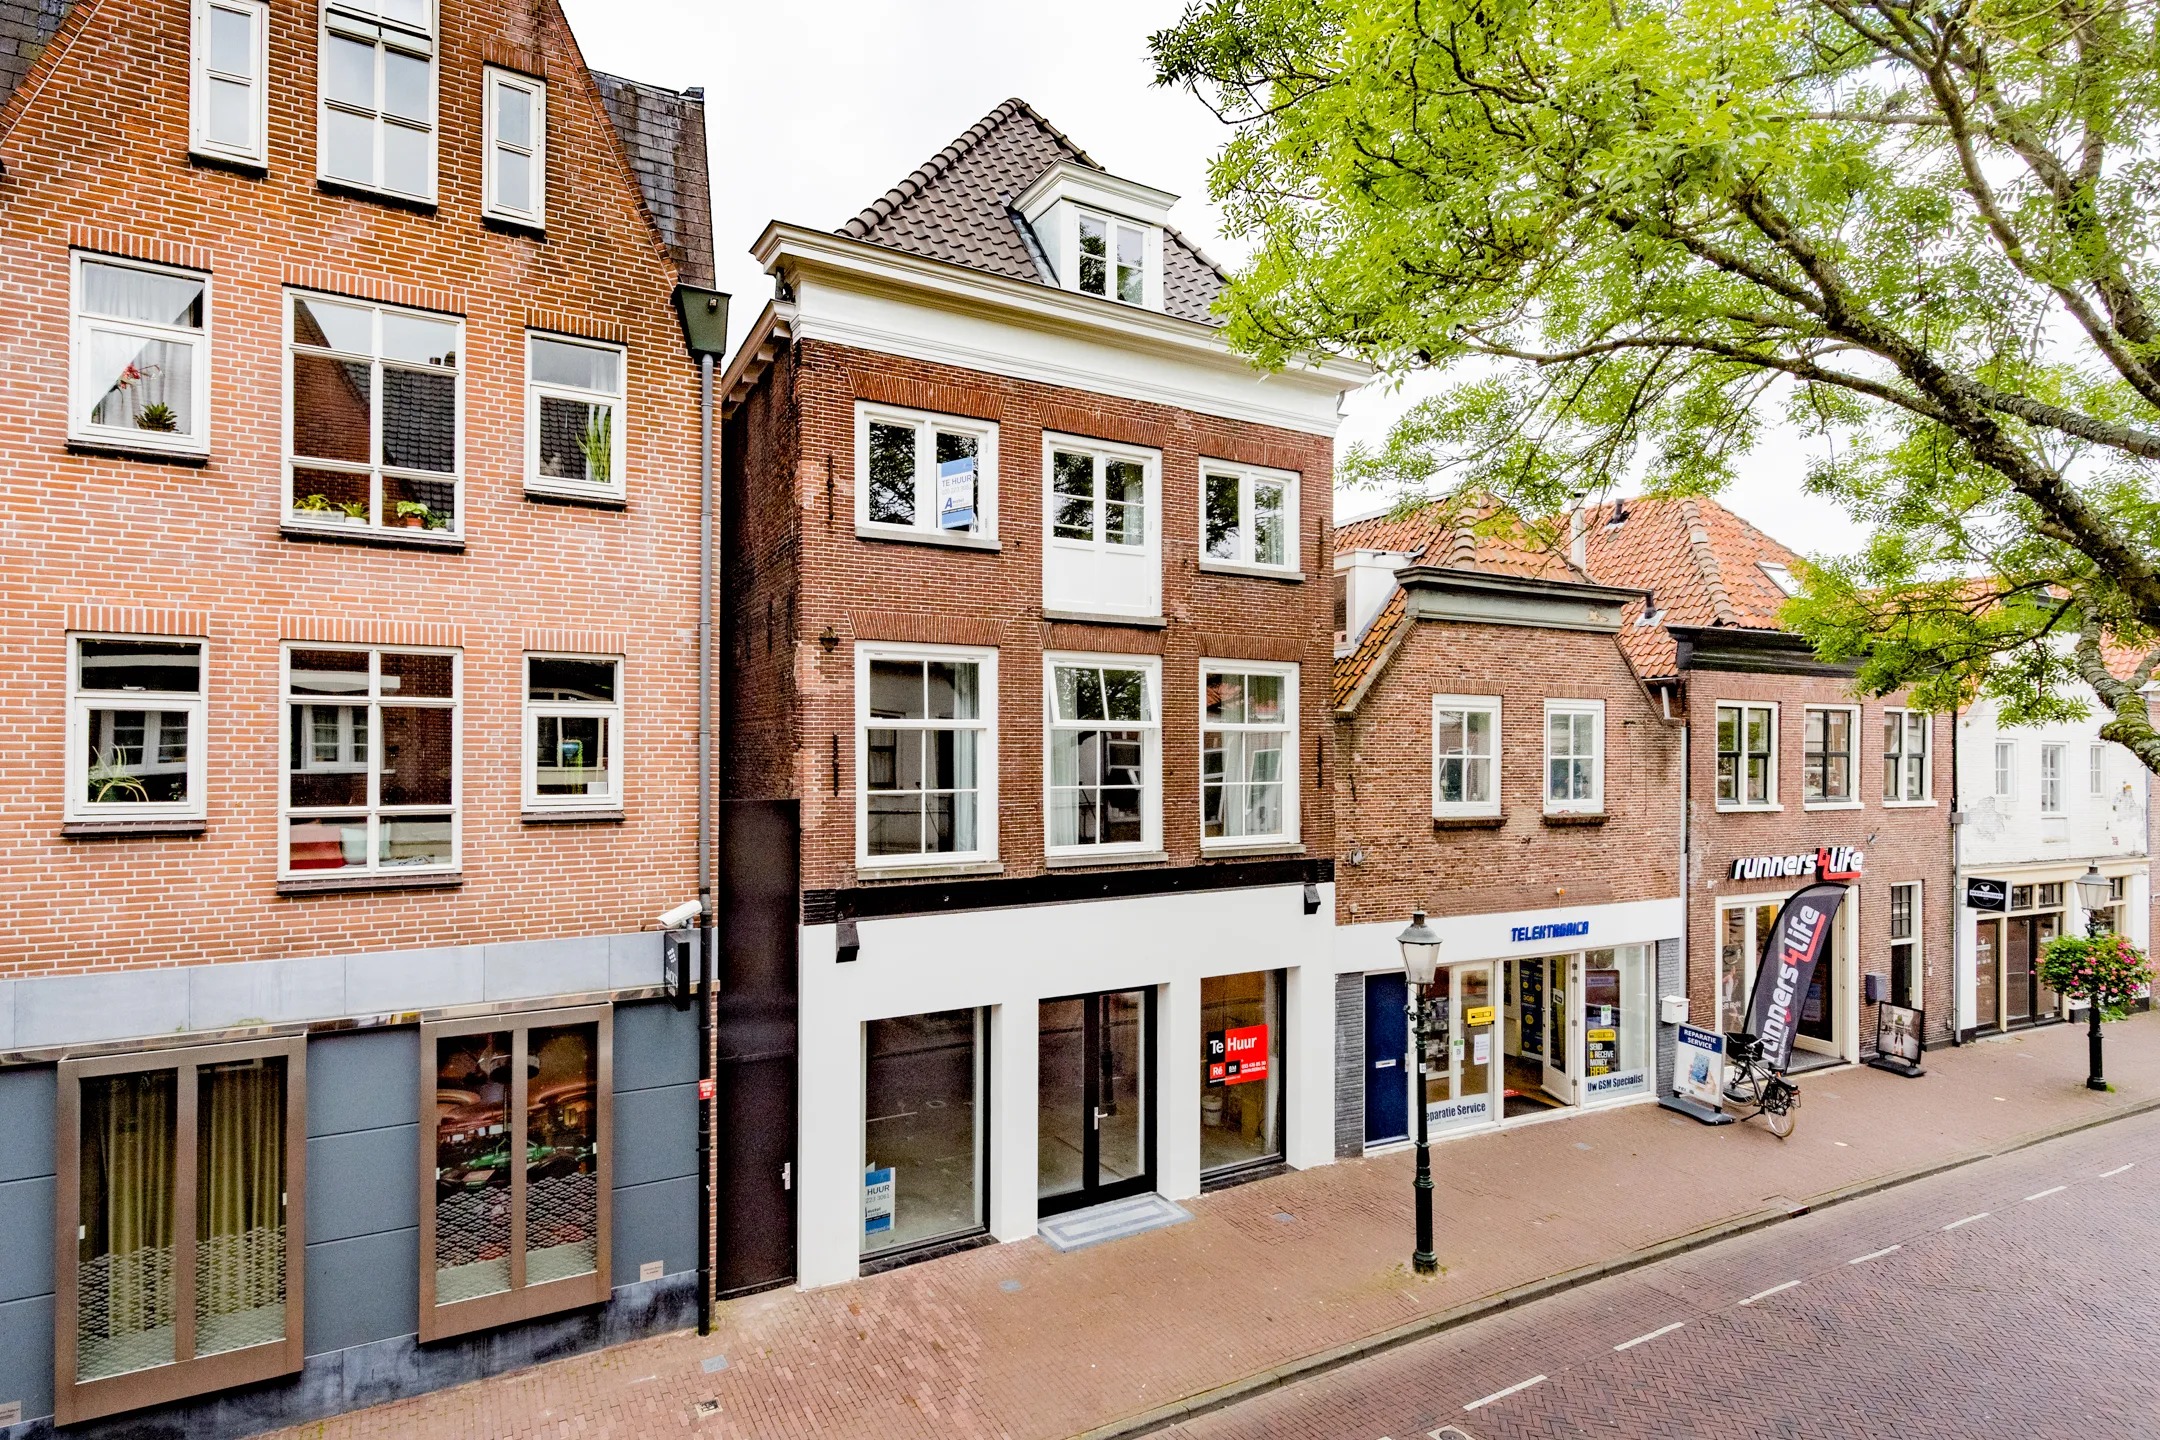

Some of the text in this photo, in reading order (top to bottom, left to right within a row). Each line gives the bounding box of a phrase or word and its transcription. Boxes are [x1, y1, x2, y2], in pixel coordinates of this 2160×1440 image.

[942, 474, 972, 487] TE HUUR
[1684, 1029, 1717, 1044] REPARATIE
[1209, 1036, 1257, 1055] Te Huur
[1589, 1042, 1603, 1051] SEND
[1687, 1037, 1713, 1050] SERVICE
[1594, 1050, 1614, 1059] RECEIVE
[1589, 1058, 1608, 1067] MONEY
[1590, 1065, 1609, 1077] HERE
[1587, 1082, 1597, 1092] Uw
[1598, 1078, 1612, 1090] GSM
[1612, 1073, 1644, 1087] Specialist
[1426, 1107, 1456, 1122] eparatie
[1457, 1102, 1486, 1116] Service
[867, 1184, 890, 1196] HUUR
